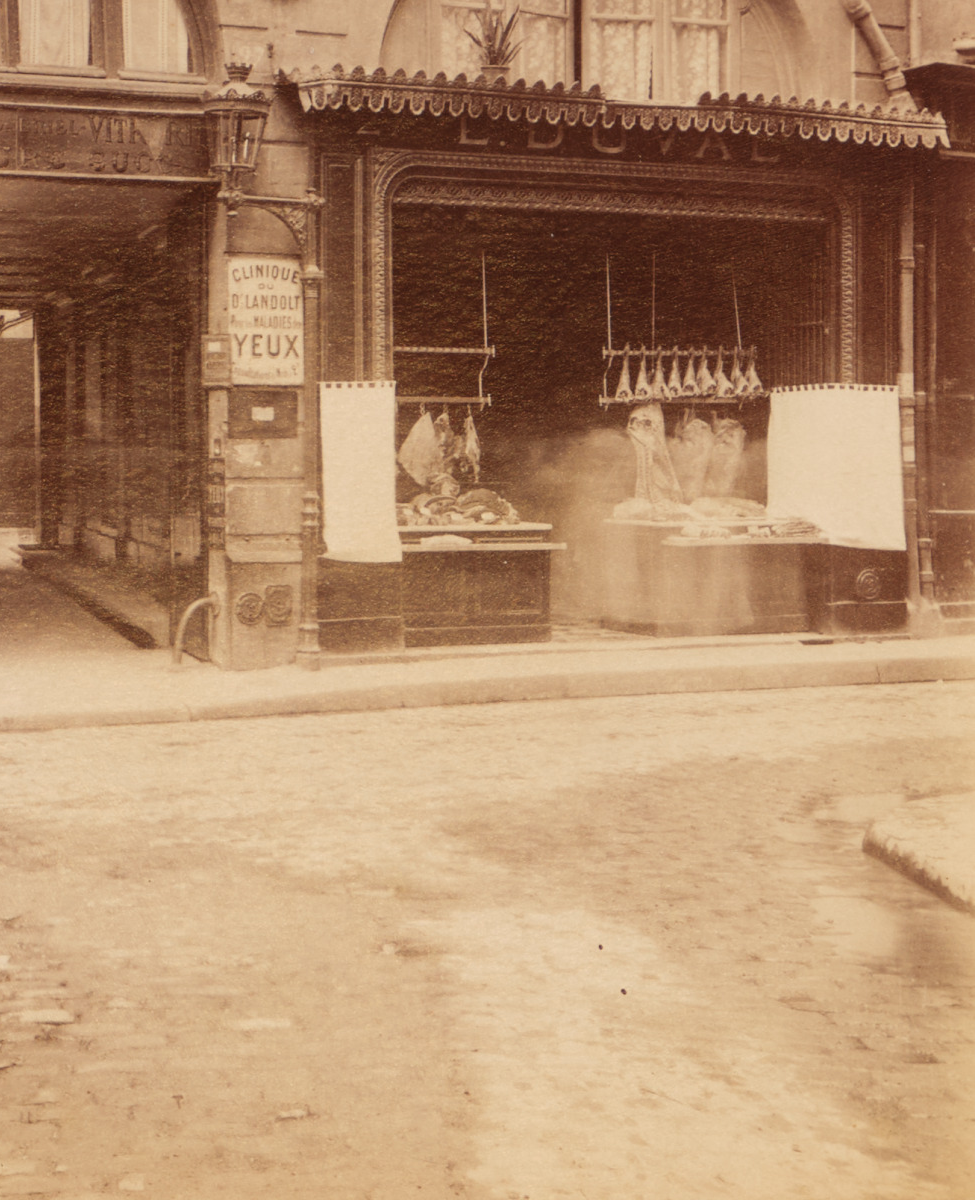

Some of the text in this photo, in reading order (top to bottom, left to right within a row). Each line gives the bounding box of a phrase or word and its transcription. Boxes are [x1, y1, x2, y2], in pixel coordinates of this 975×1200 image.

[232, 264, 300, 285] CLINIQUE
[246, 294, 301, 311] LANDOLT
[233, 333, 300, 358] YEUX
